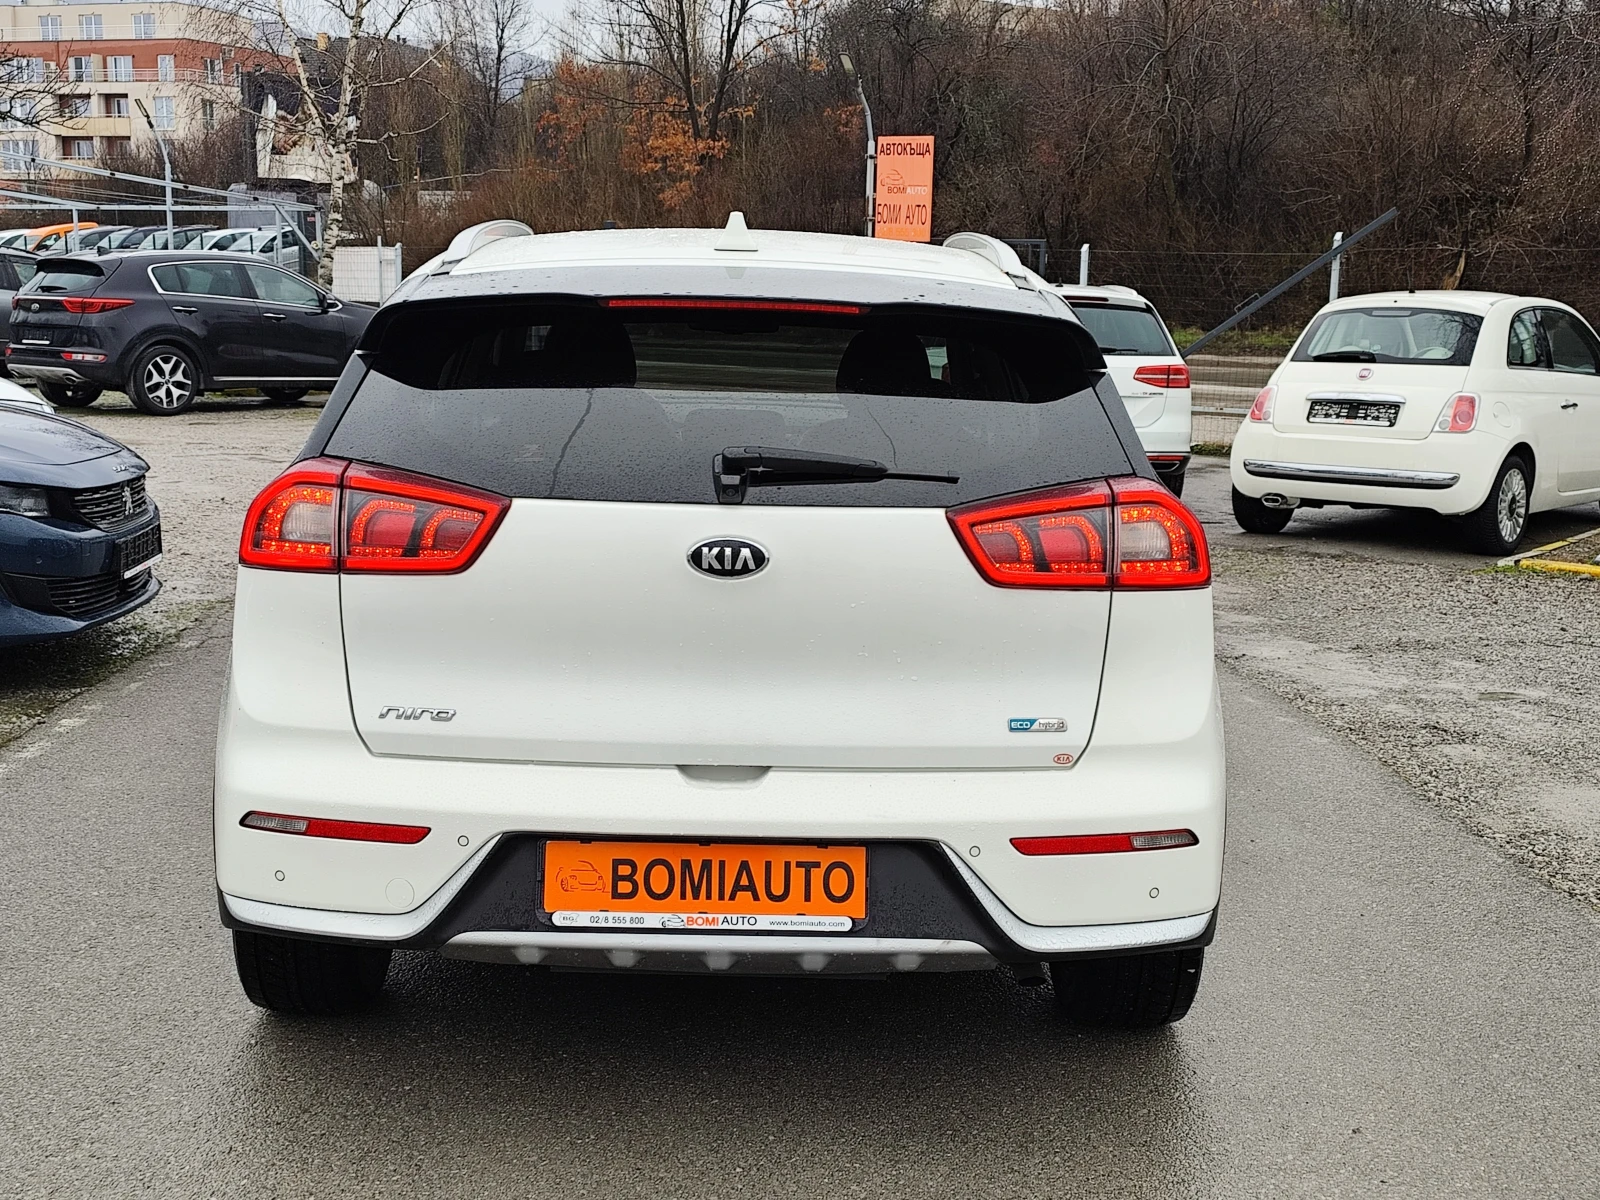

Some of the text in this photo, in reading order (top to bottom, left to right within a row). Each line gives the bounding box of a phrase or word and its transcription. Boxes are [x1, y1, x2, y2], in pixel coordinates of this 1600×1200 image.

[879, 142, 931, 158] АВТОКЪЩА
[877, 203, 928, 226] БОМИ АУТО
[701, 546, 756, 570] KIA
[1011, 721, 1065, 730] ECO hybrid
[610, 857, 856, 905] BOMIAUTO
[589, 915, 609, 925] 02/8
[612, 916, 627, 925] 555
[629, 916, 645, 925] 800
[768, 918, 846, 929] www.bomiauto.com
